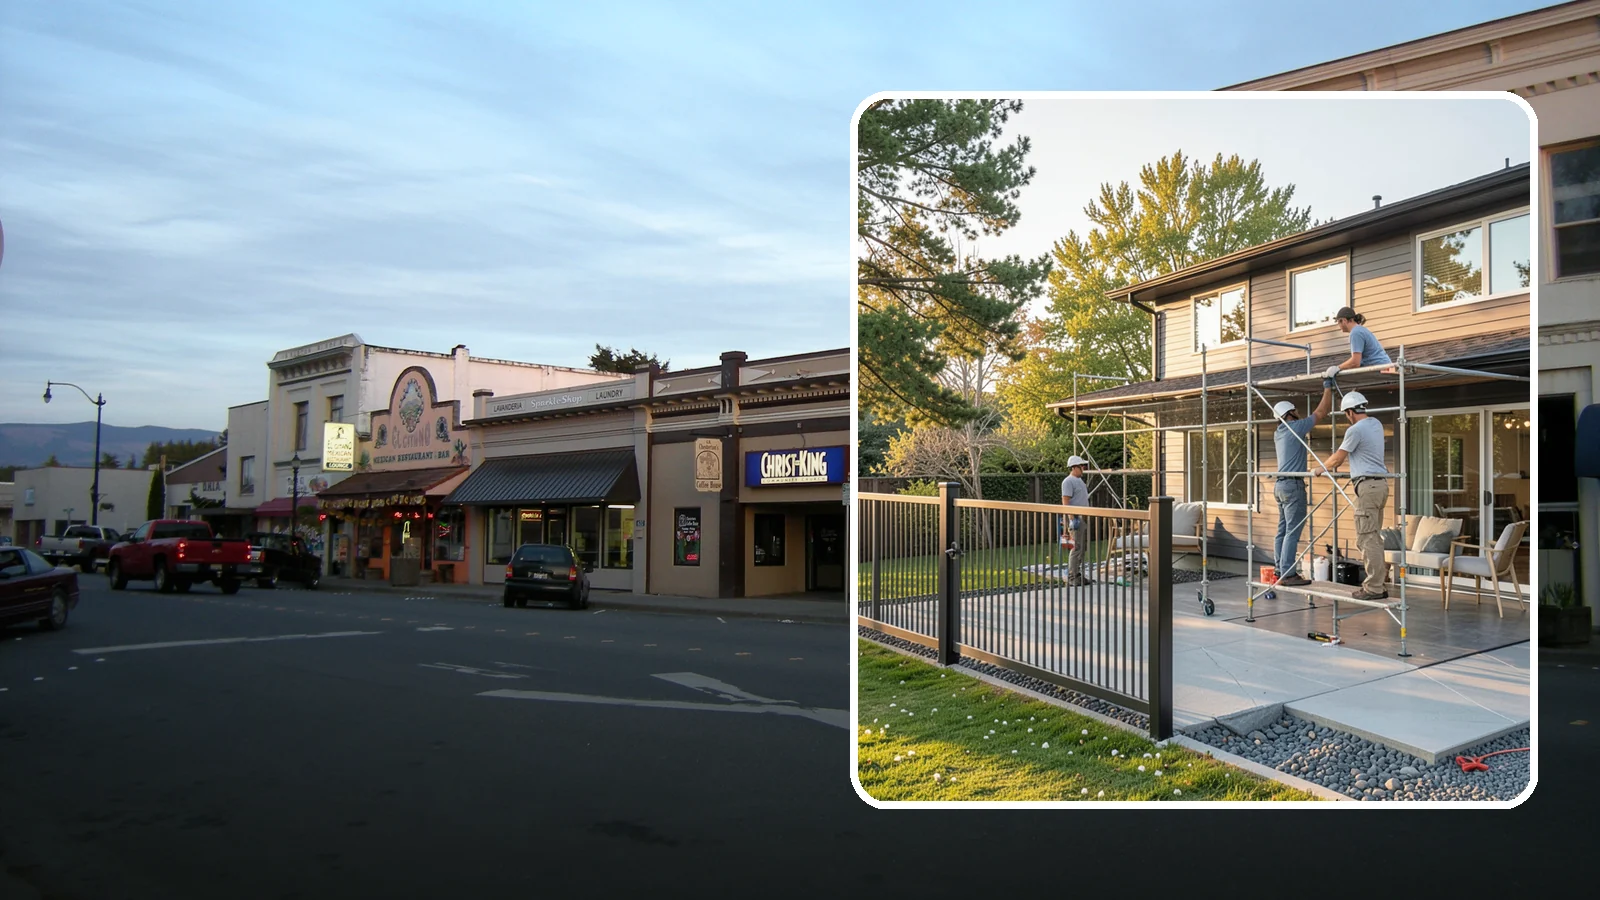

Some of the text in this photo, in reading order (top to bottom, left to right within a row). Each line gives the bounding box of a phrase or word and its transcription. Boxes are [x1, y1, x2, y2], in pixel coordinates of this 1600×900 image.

[595, 389, 624, 400] LAUNDRY
[493, 402, 523, 413] LAVANDERIA
[530, 395, 583, 410] Sparkle Shop
[373, 450, 450, 464] MEXICAN RESTAURANT BAR
